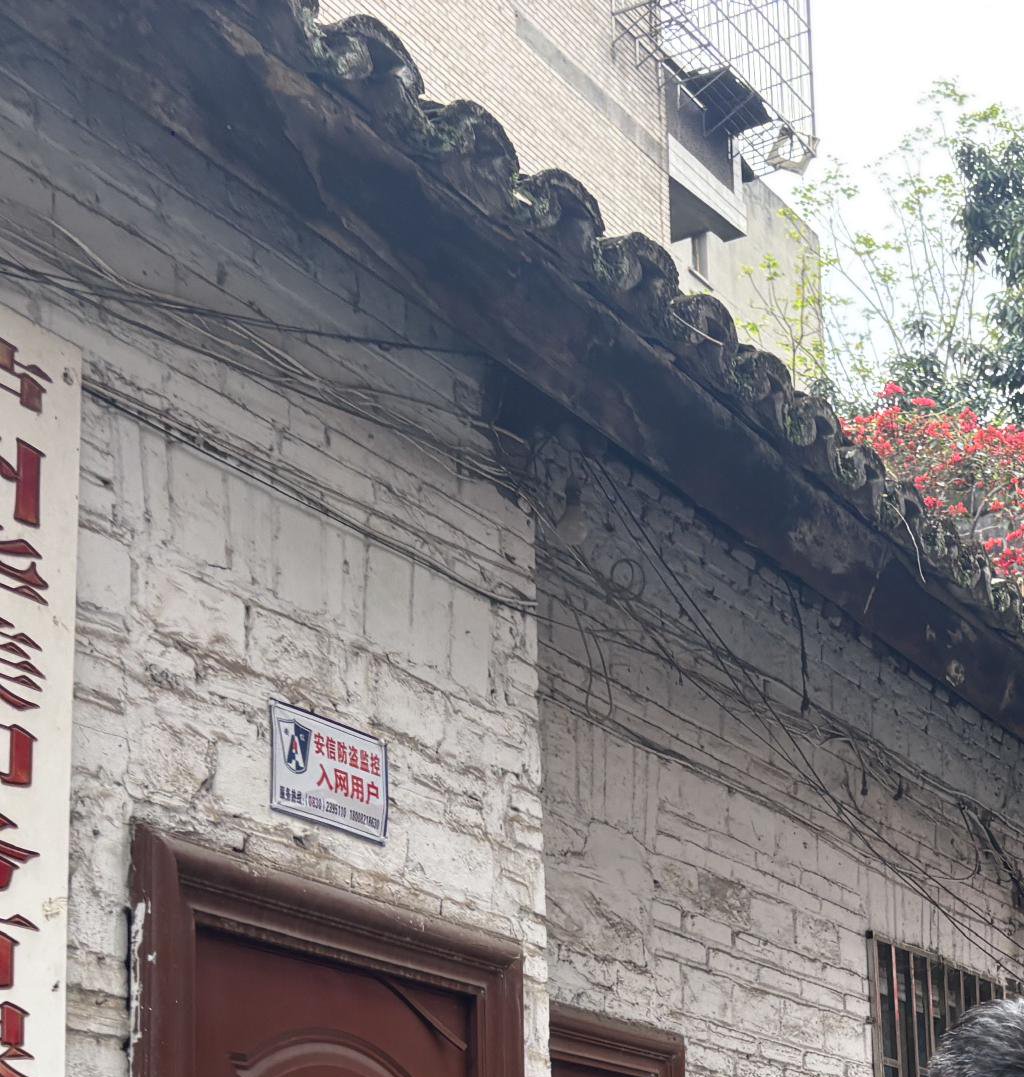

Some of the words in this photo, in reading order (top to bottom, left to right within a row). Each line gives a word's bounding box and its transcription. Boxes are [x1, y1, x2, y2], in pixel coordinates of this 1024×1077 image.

[314, 732, 380, 776] 安信防盗监控
[316, 763, 380, 804] 入网用户
